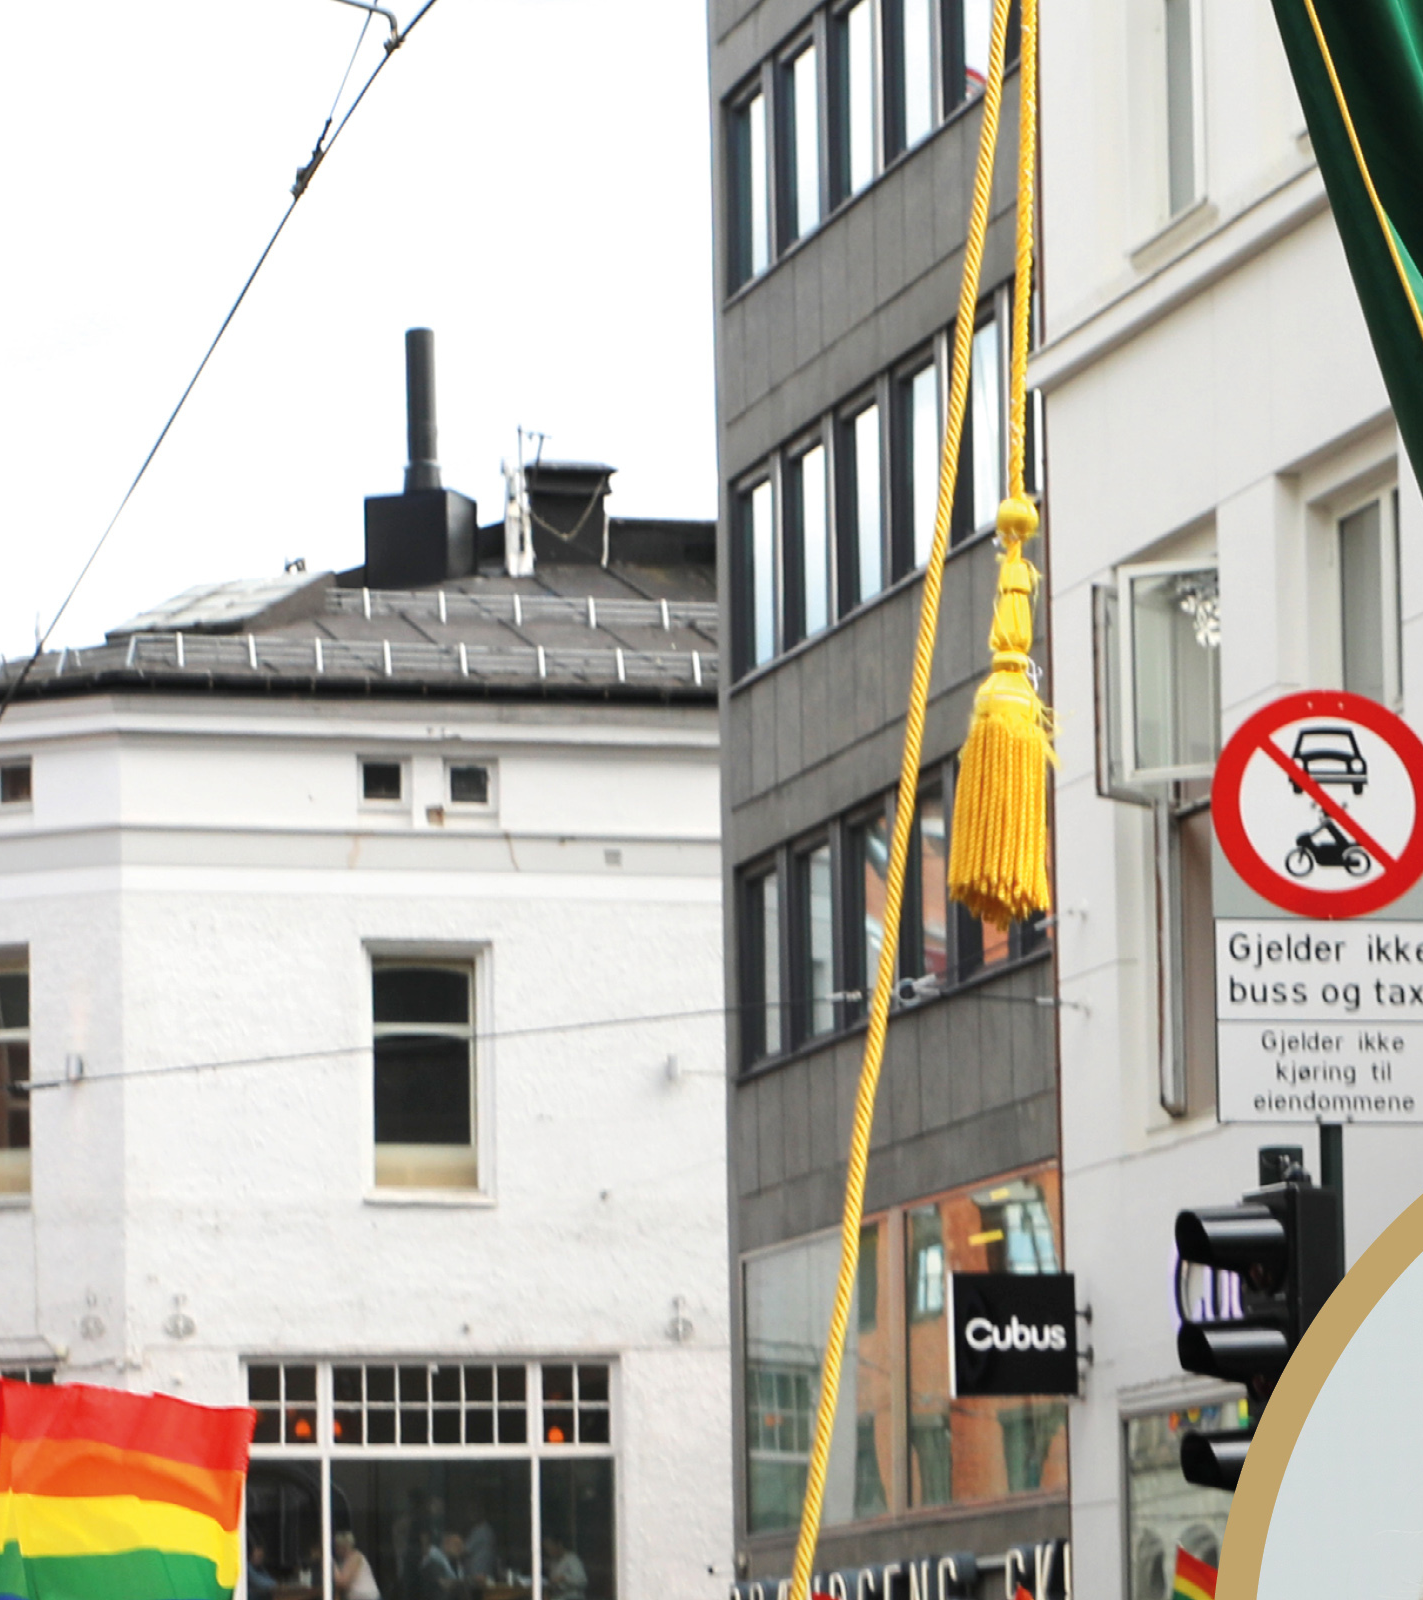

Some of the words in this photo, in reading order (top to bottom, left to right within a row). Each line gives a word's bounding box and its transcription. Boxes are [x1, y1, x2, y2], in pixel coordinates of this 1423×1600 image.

[1228, 932, 1346, 968] Gjelder
[1228, 975, 1308, 1005] buss
[1320, 983, 1361, 1012] og
[1260, 1030, 1343, 1057] Gjelder
[1357, 1033, 1405, 1053] ikke
[1275, 1060, 1357, 1086] kjøring
[1371, 1062, 1392, 1082] til
[1253, 1091, 1415, 1113] eiendommene
[964, 1315, 1067, 1351] Cubus
